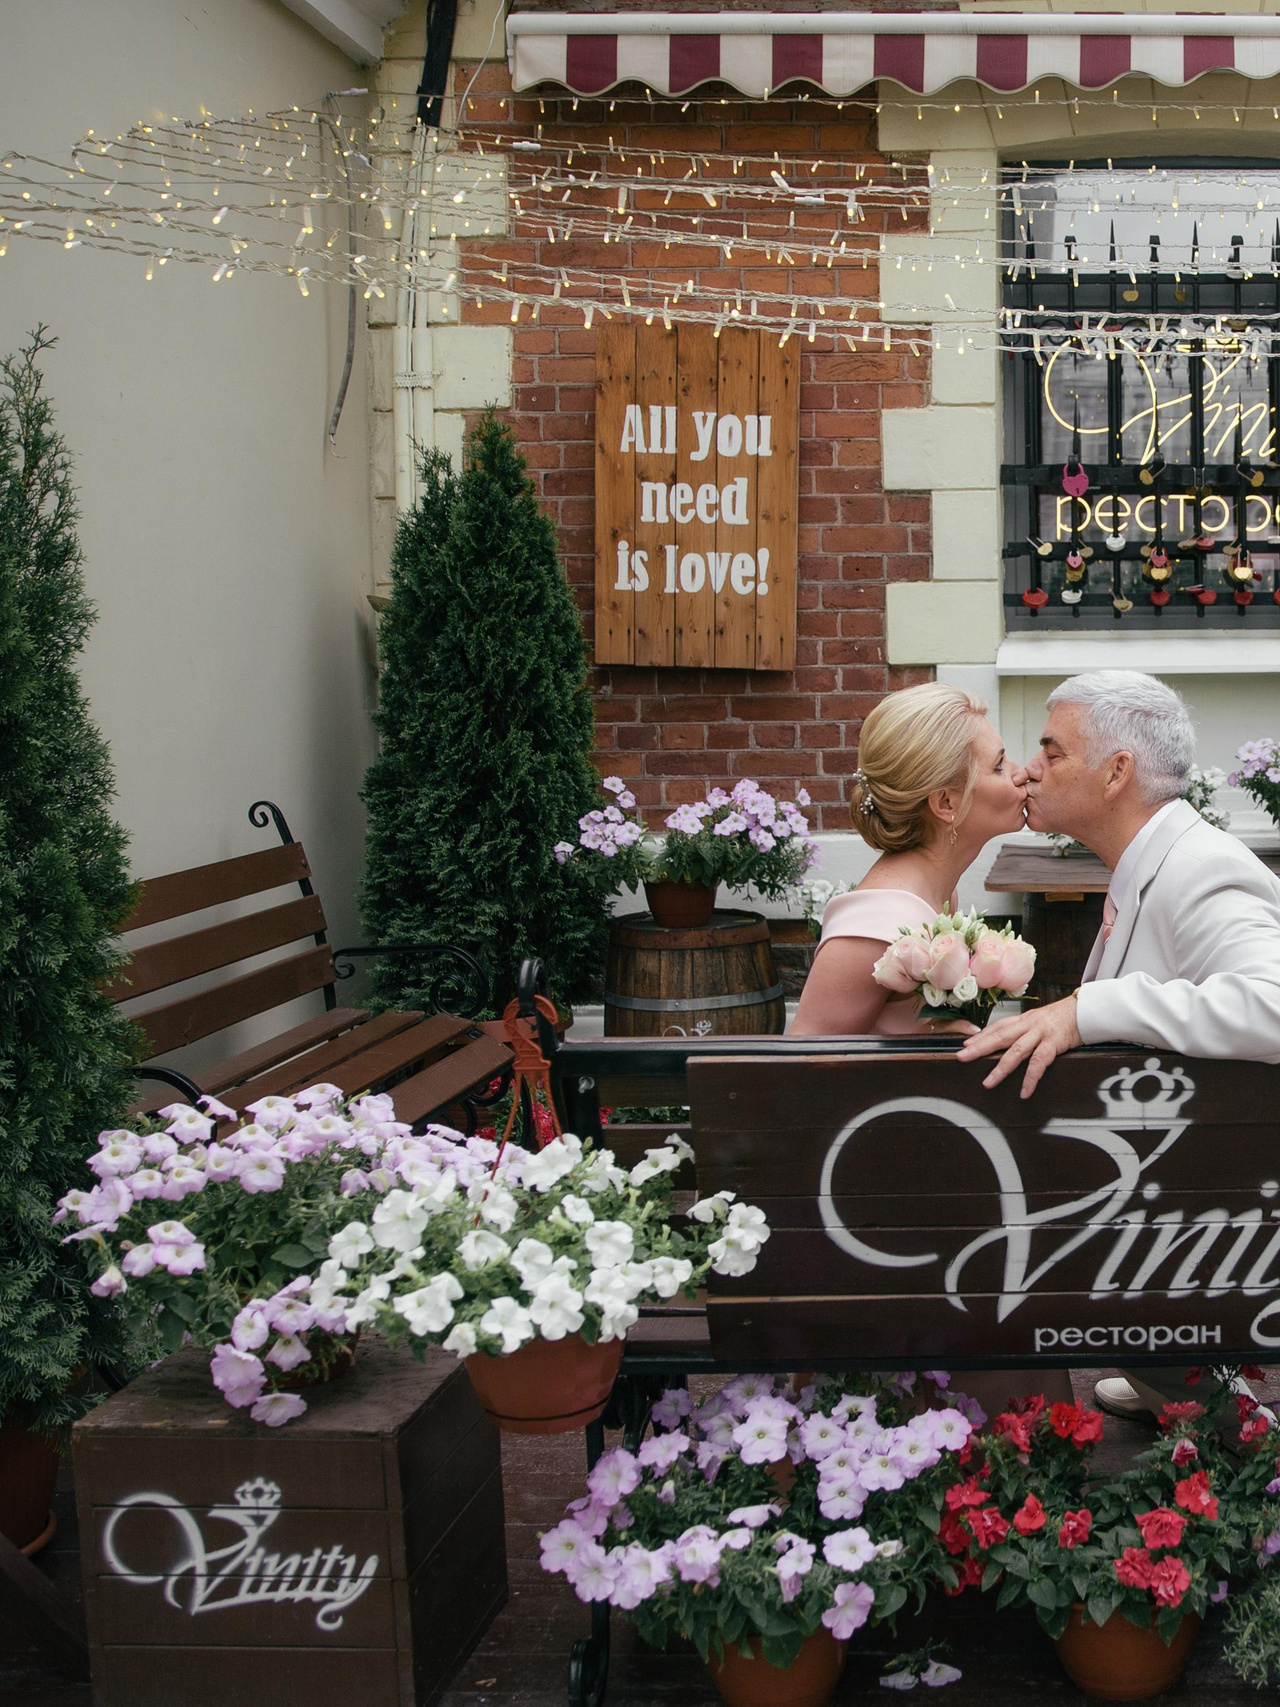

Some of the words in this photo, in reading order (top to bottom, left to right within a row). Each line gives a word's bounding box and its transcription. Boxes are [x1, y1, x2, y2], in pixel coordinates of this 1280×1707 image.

[620, 404, 677, 454] All
[690, 411, 772, 461] you
[640, 477, 749, 525] need
[614, 540, 649, 592] is
[664, 545, 770, 595] love!
[1034, 1325, 1222, 1352] ресторан
[103, 1491, 379, 1631] Vinity
